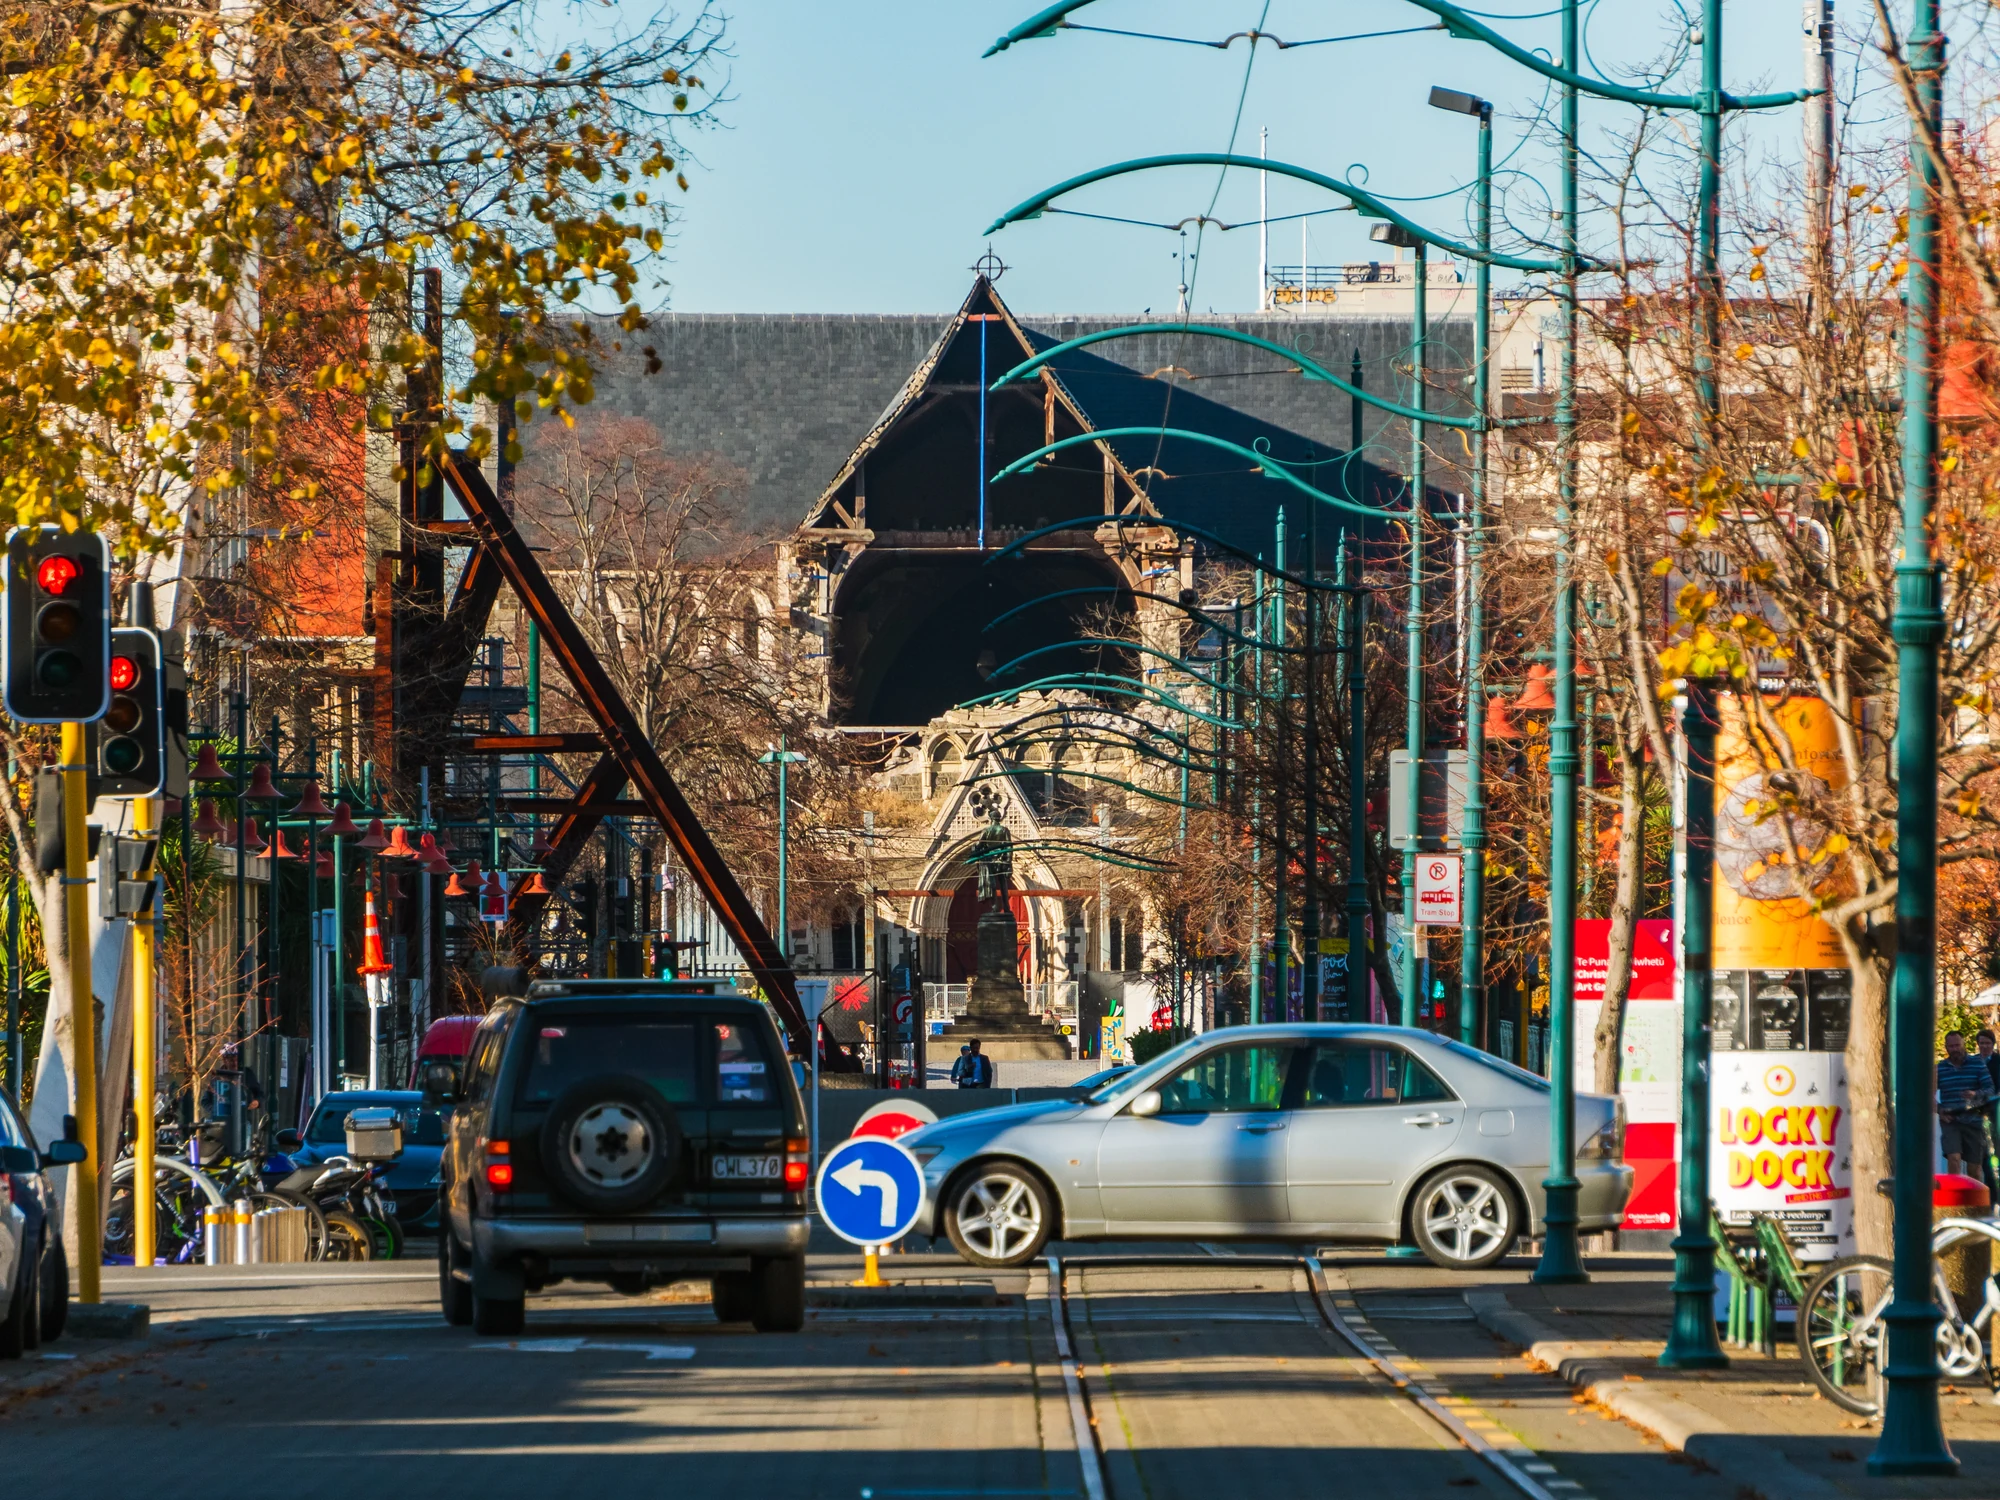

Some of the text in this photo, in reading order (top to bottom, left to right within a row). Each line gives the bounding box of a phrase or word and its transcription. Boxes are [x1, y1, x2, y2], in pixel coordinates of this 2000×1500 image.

[1421, 908, 1455, 917] Tram Stop
[1716, 911, 1752, 925] lence
[1577, 957, 1588, 967] Te
[1635, 957, 1665, 967] iwhetū
[1324, 969, 1343, 982] Show
[1576, 969, 1638, 979] Christh
[1576, 982, 1592, 991] Art
[1720, 1105, 1841, 1145] LOCKY
[714, 1158, 779, 1177] CWL370
[1728, 1150, 1836, 1189] DOCK
[1787, 1211, 1827, 1221] recharge
